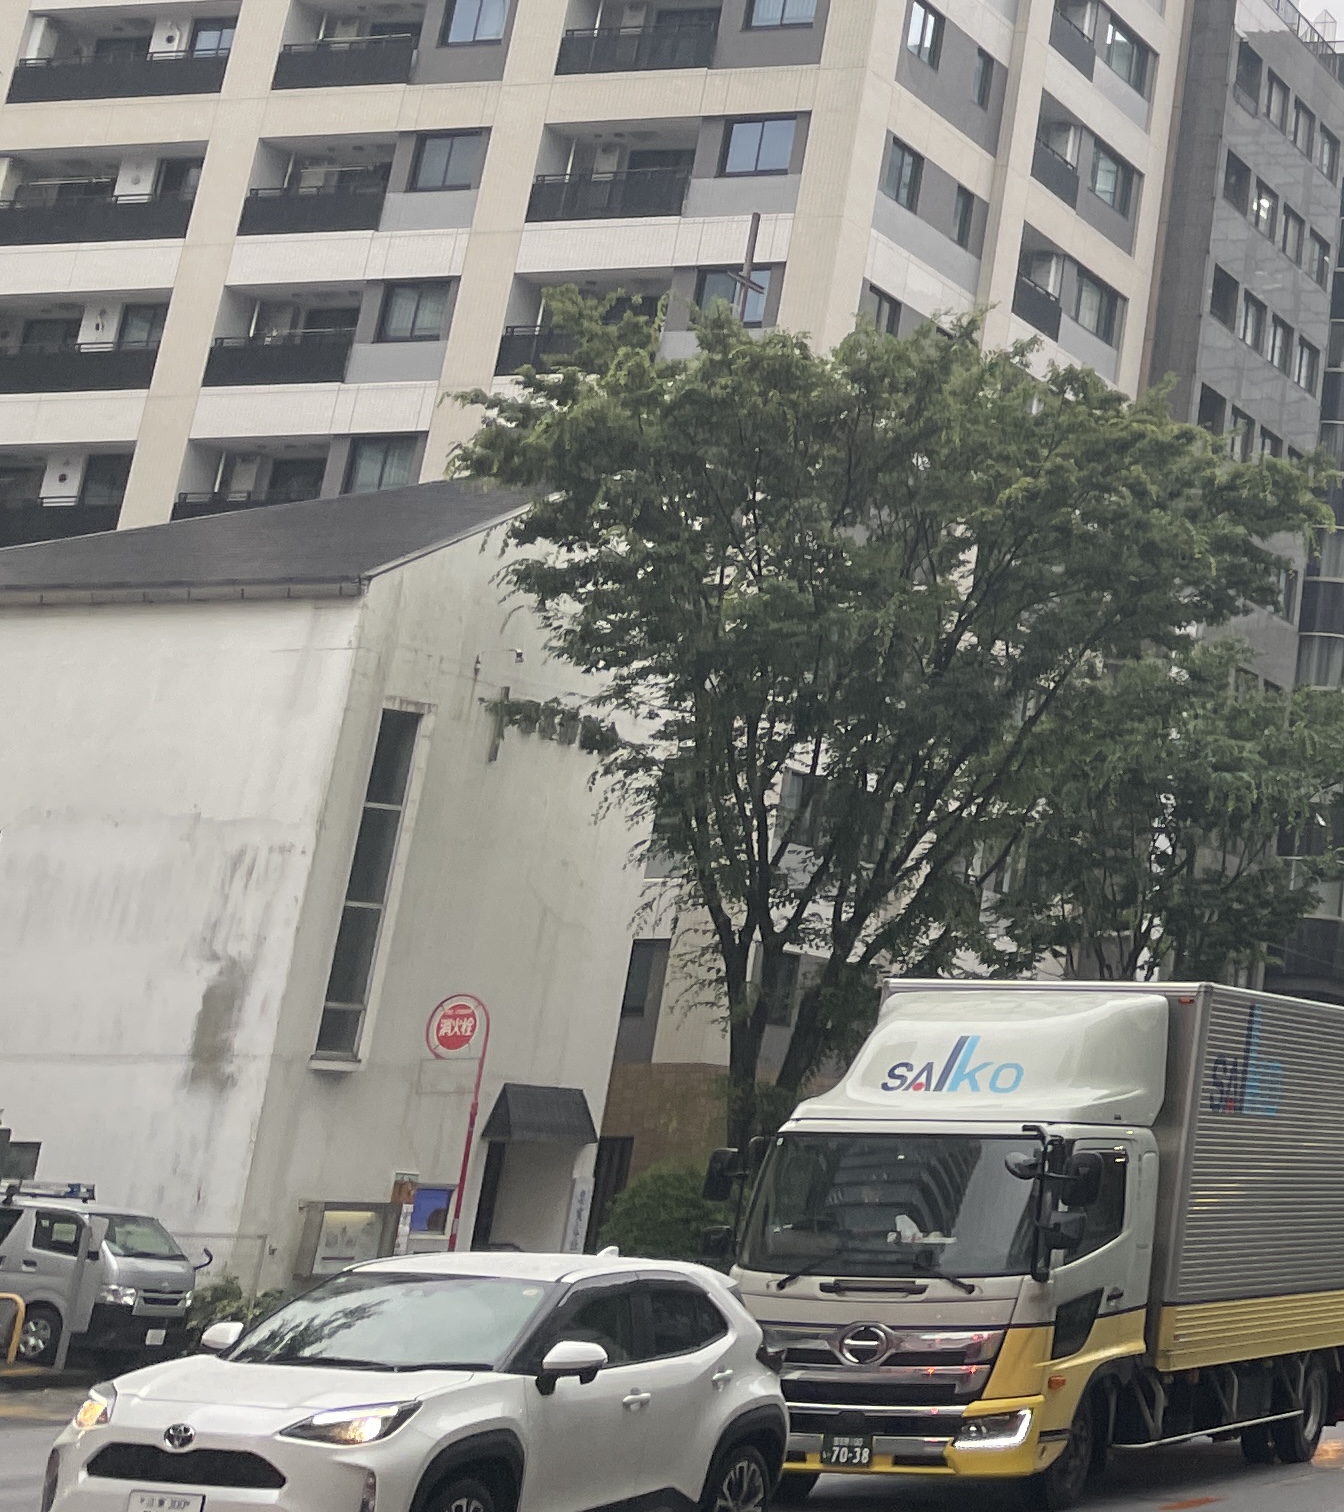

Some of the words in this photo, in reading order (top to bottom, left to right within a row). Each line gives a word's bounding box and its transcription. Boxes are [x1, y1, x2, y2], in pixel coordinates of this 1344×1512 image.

[438, 1017, 475, 1037] 消火栓
[831, 1446, 870, 1464] 70-38
